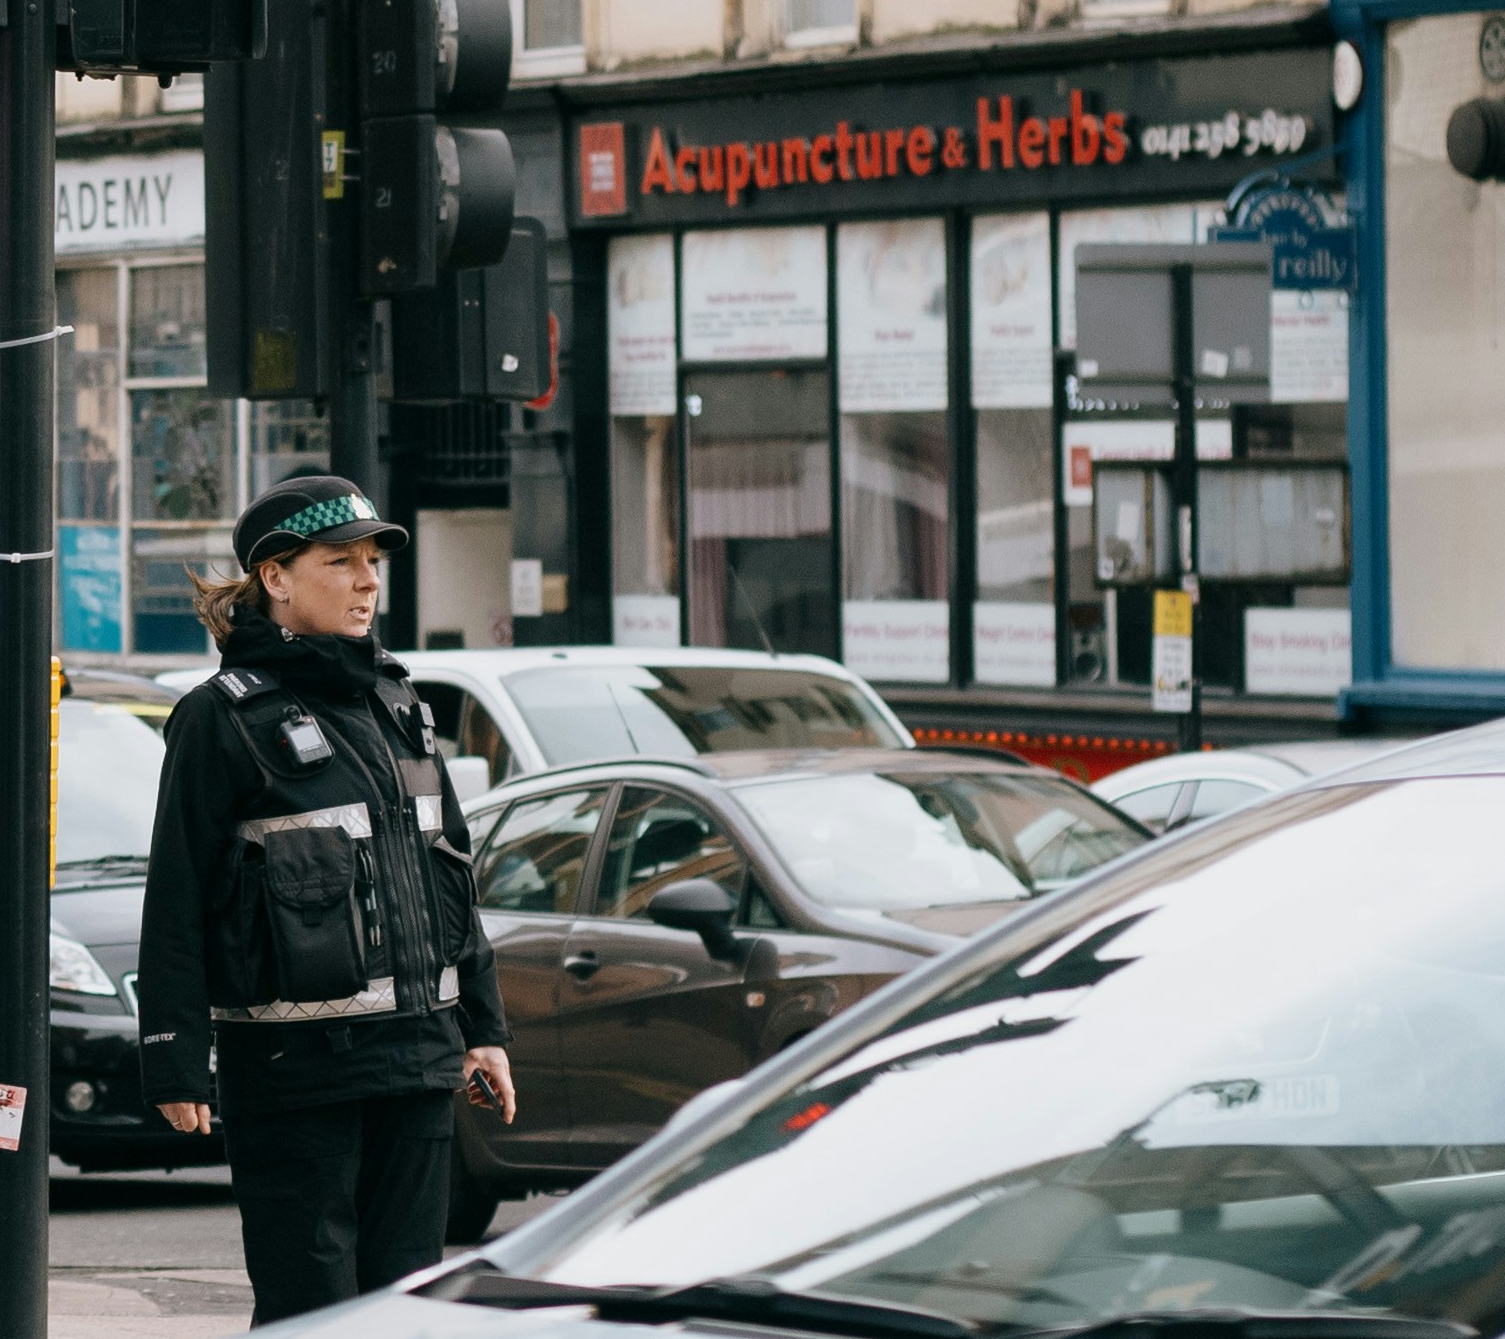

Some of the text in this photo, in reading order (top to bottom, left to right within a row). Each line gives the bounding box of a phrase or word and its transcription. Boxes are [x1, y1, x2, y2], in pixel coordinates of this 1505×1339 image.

[642, 120, 933, 206] Acupuncture
[942, 127, 967, 169] &
[976, 89, 1127, 171] Herbs
[55, 173, 174, 233] ADEMY
[1278, 248, 1348, 282] reilly
